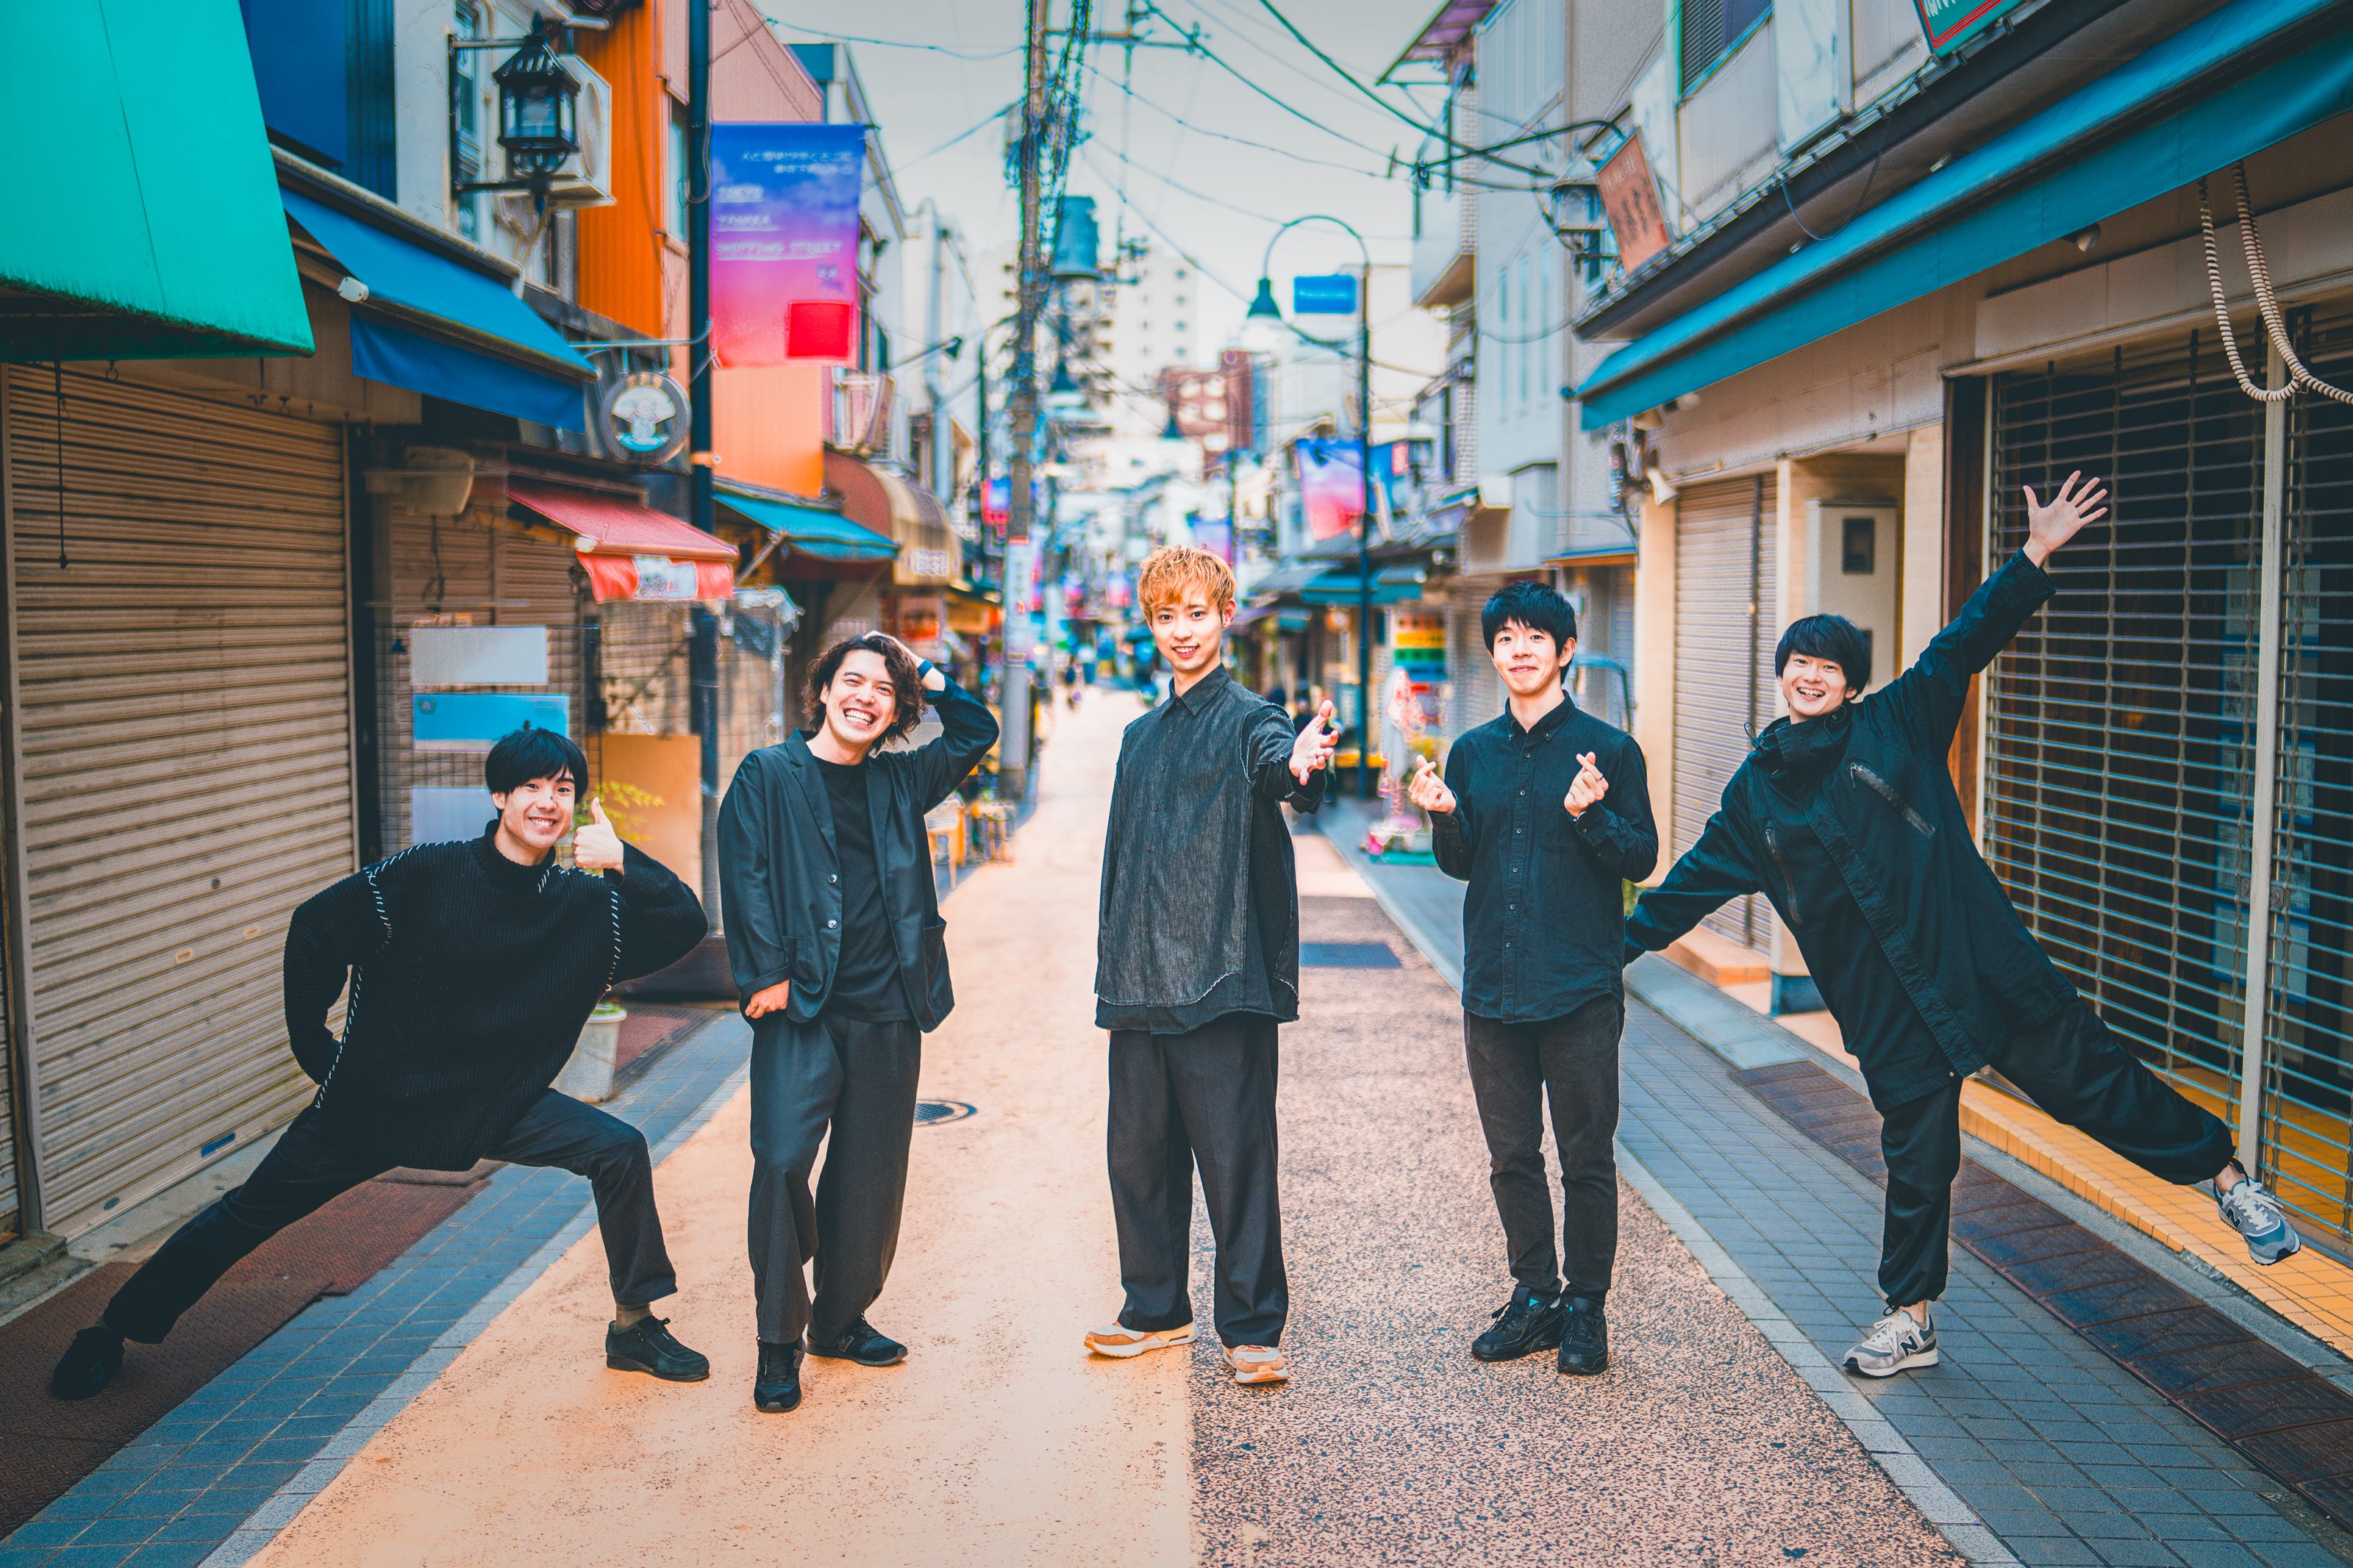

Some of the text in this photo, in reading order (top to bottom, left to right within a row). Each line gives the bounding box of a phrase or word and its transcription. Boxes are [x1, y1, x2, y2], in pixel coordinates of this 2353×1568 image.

[789, 240, 843, 254] STREET
[2226, 1206, 2241, 1230] N
[1899, 1334, 1920, 1358] N
